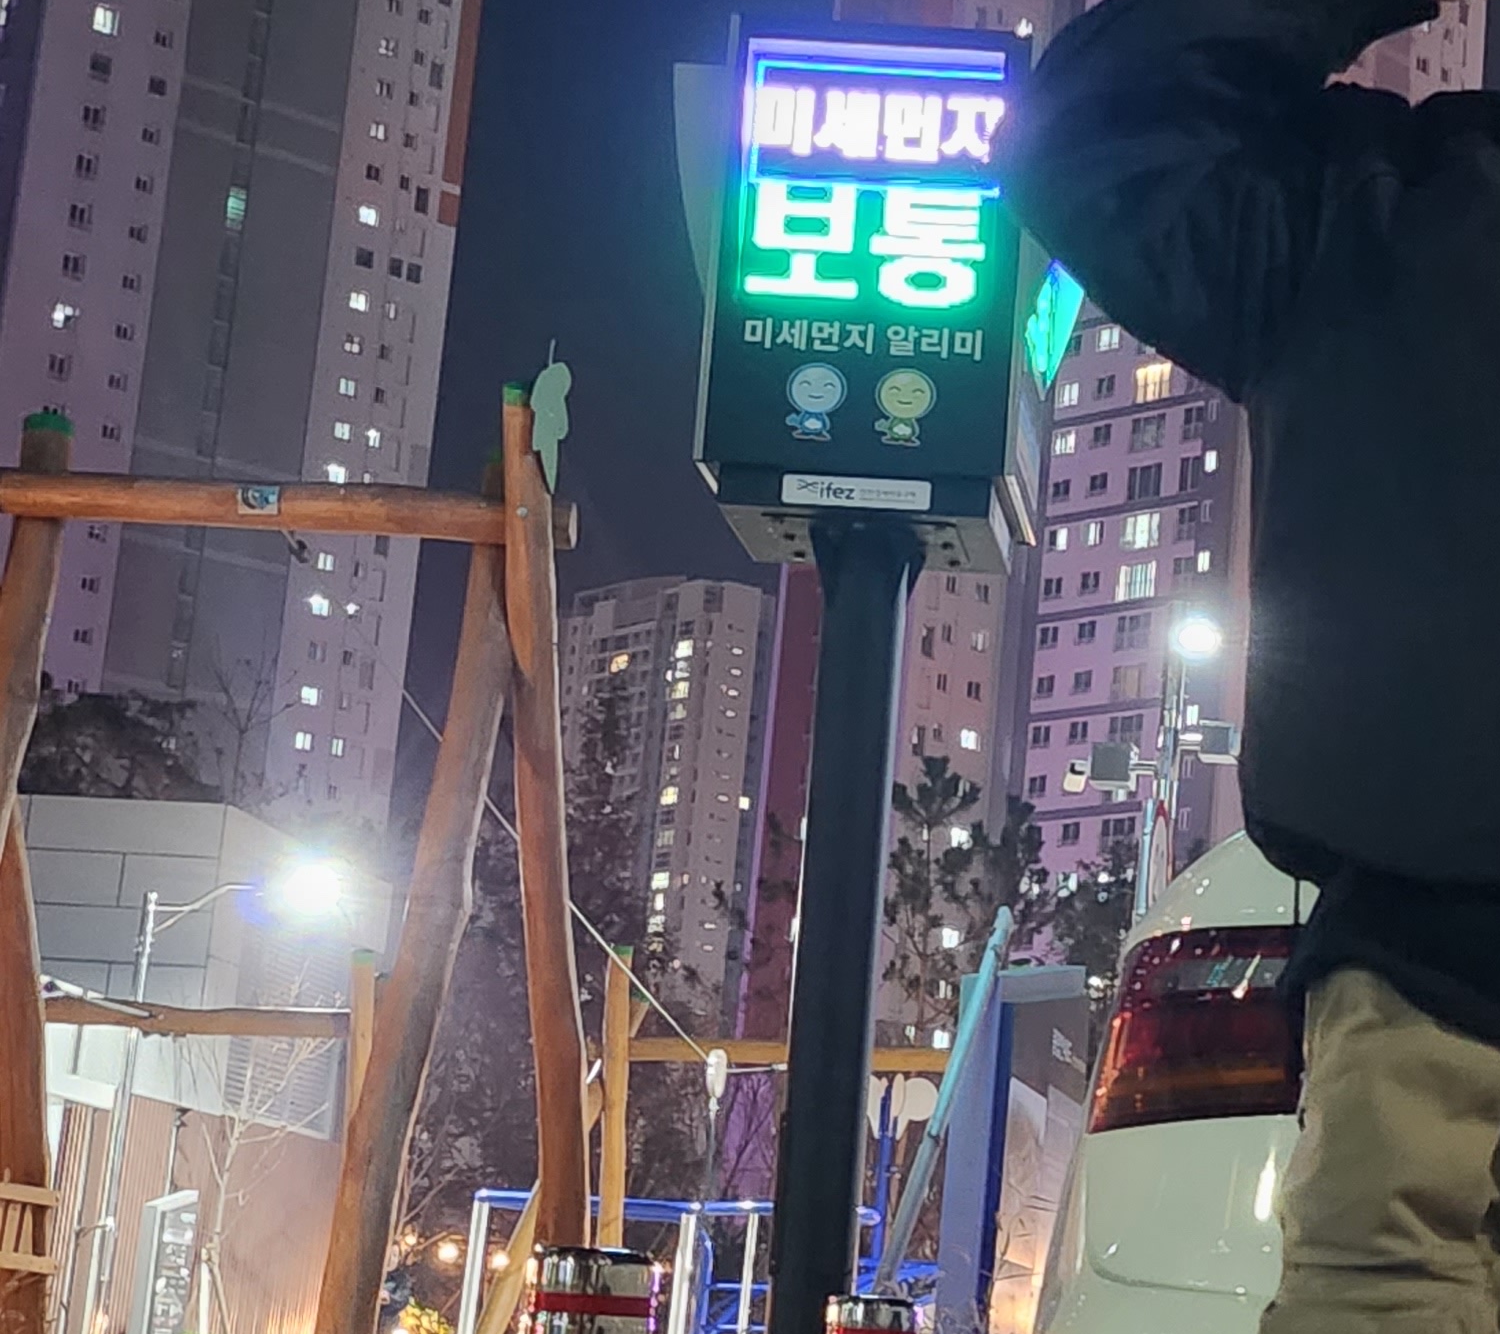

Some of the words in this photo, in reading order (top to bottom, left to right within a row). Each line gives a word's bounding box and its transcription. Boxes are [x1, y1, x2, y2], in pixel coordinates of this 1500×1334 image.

[744, 182, 986, 308] 보통
[743, 317, 876, 355] 미세먼지
[886, 325, 983, 361] 알리미
[819, 481, 856, 501] ifez
